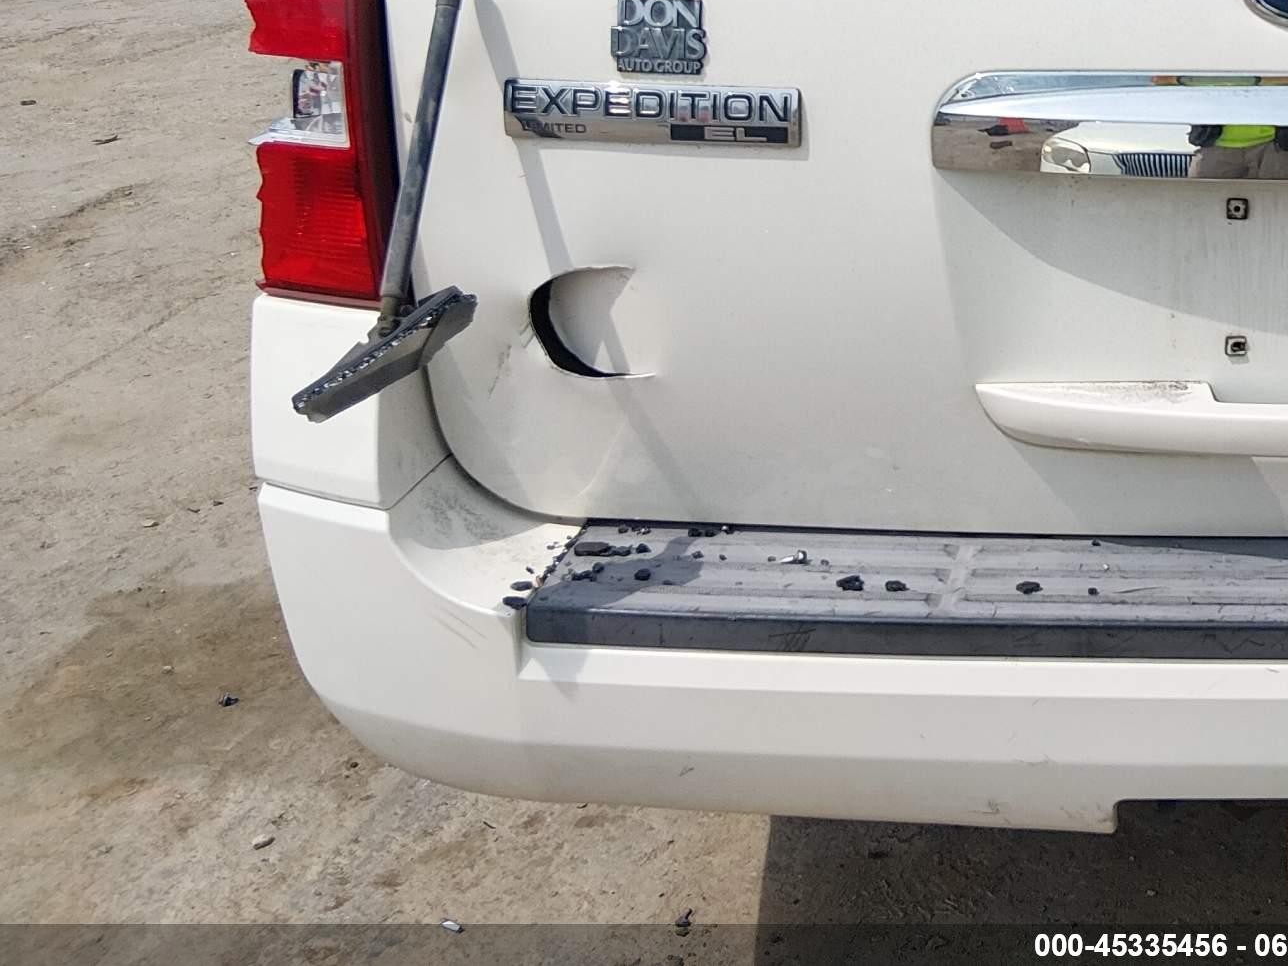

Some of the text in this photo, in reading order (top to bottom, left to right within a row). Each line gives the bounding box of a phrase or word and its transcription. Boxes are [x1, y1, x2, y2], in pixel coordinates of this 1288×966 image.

[612, 26, 707, 60] DAVIS
[617, 58, 702, 75] AUTO GROUP
[510, 84, 792, 123] EXPEDITION
[521, 120, 587, 135] LIMITED
[704, 126, 768, 143] EL
